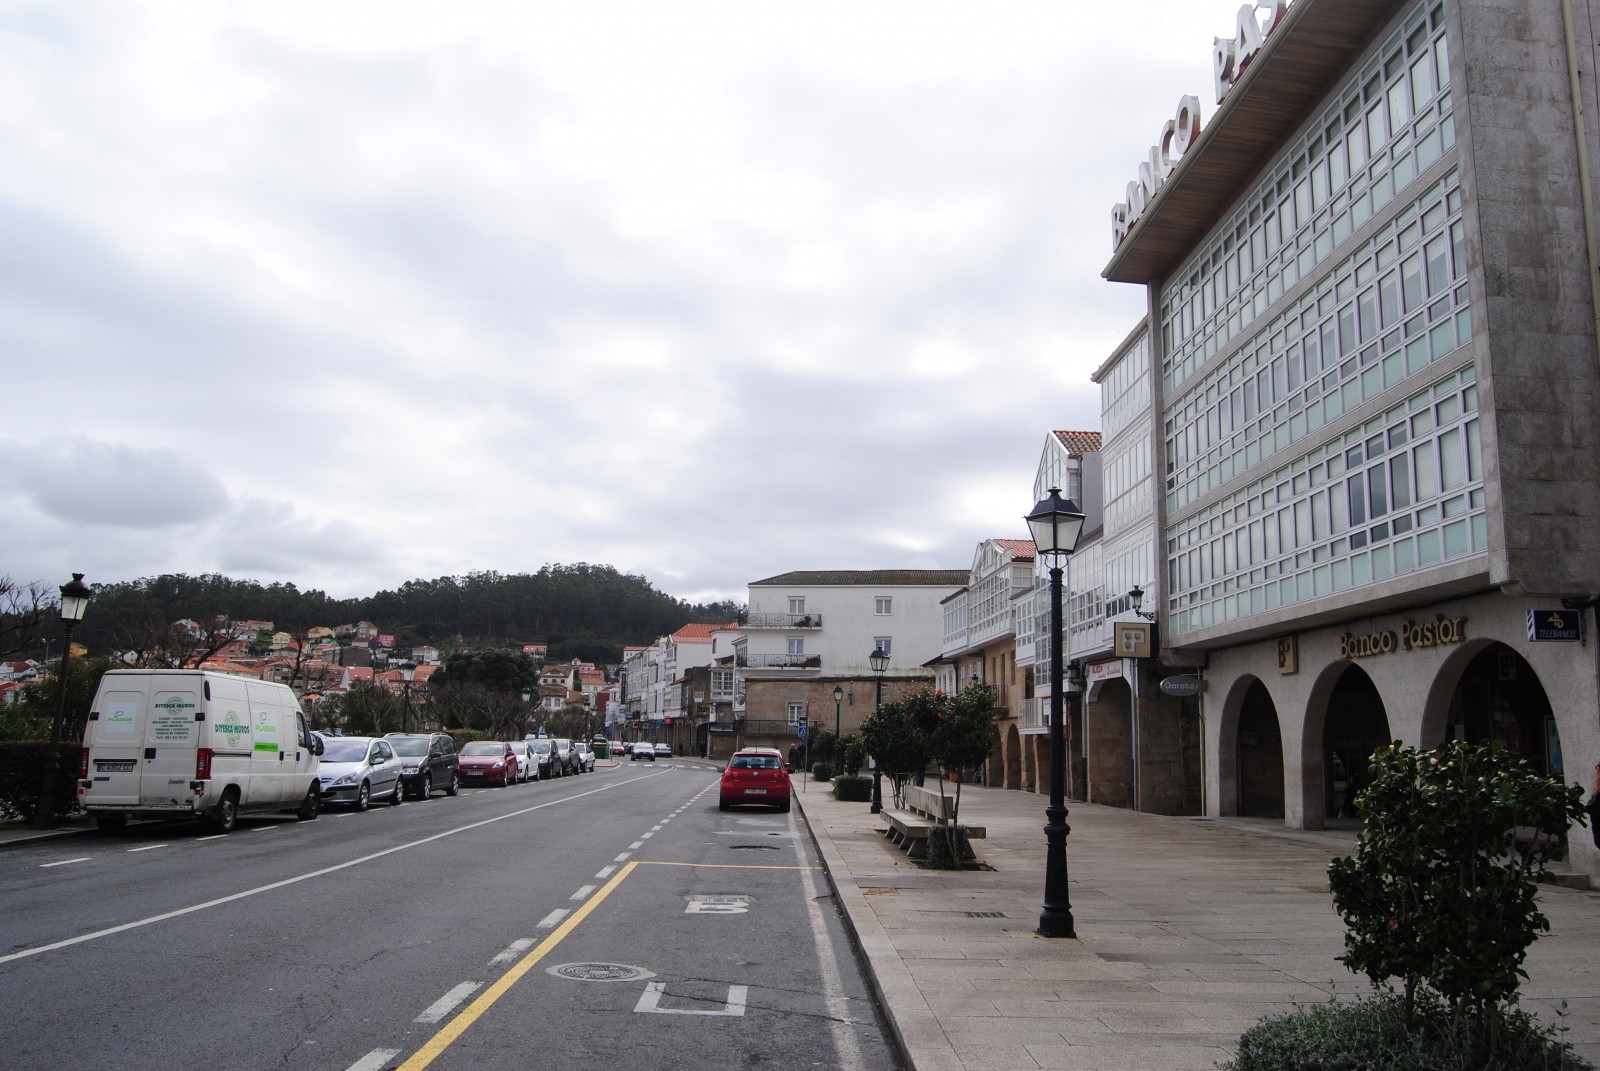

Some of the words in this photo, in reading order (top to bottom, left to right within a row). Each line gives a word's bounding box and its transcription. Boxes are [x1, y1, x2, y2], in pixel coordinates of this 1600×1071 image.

[1111, 93, 1201, 253] BANCO
[1340, 630, 1395, 659] Banco
[1400, 616, 1462, 651] Pastor
[1539, 629, 1576, 638] TELEBANCO
[234, 725, 250, 734] MUROS
